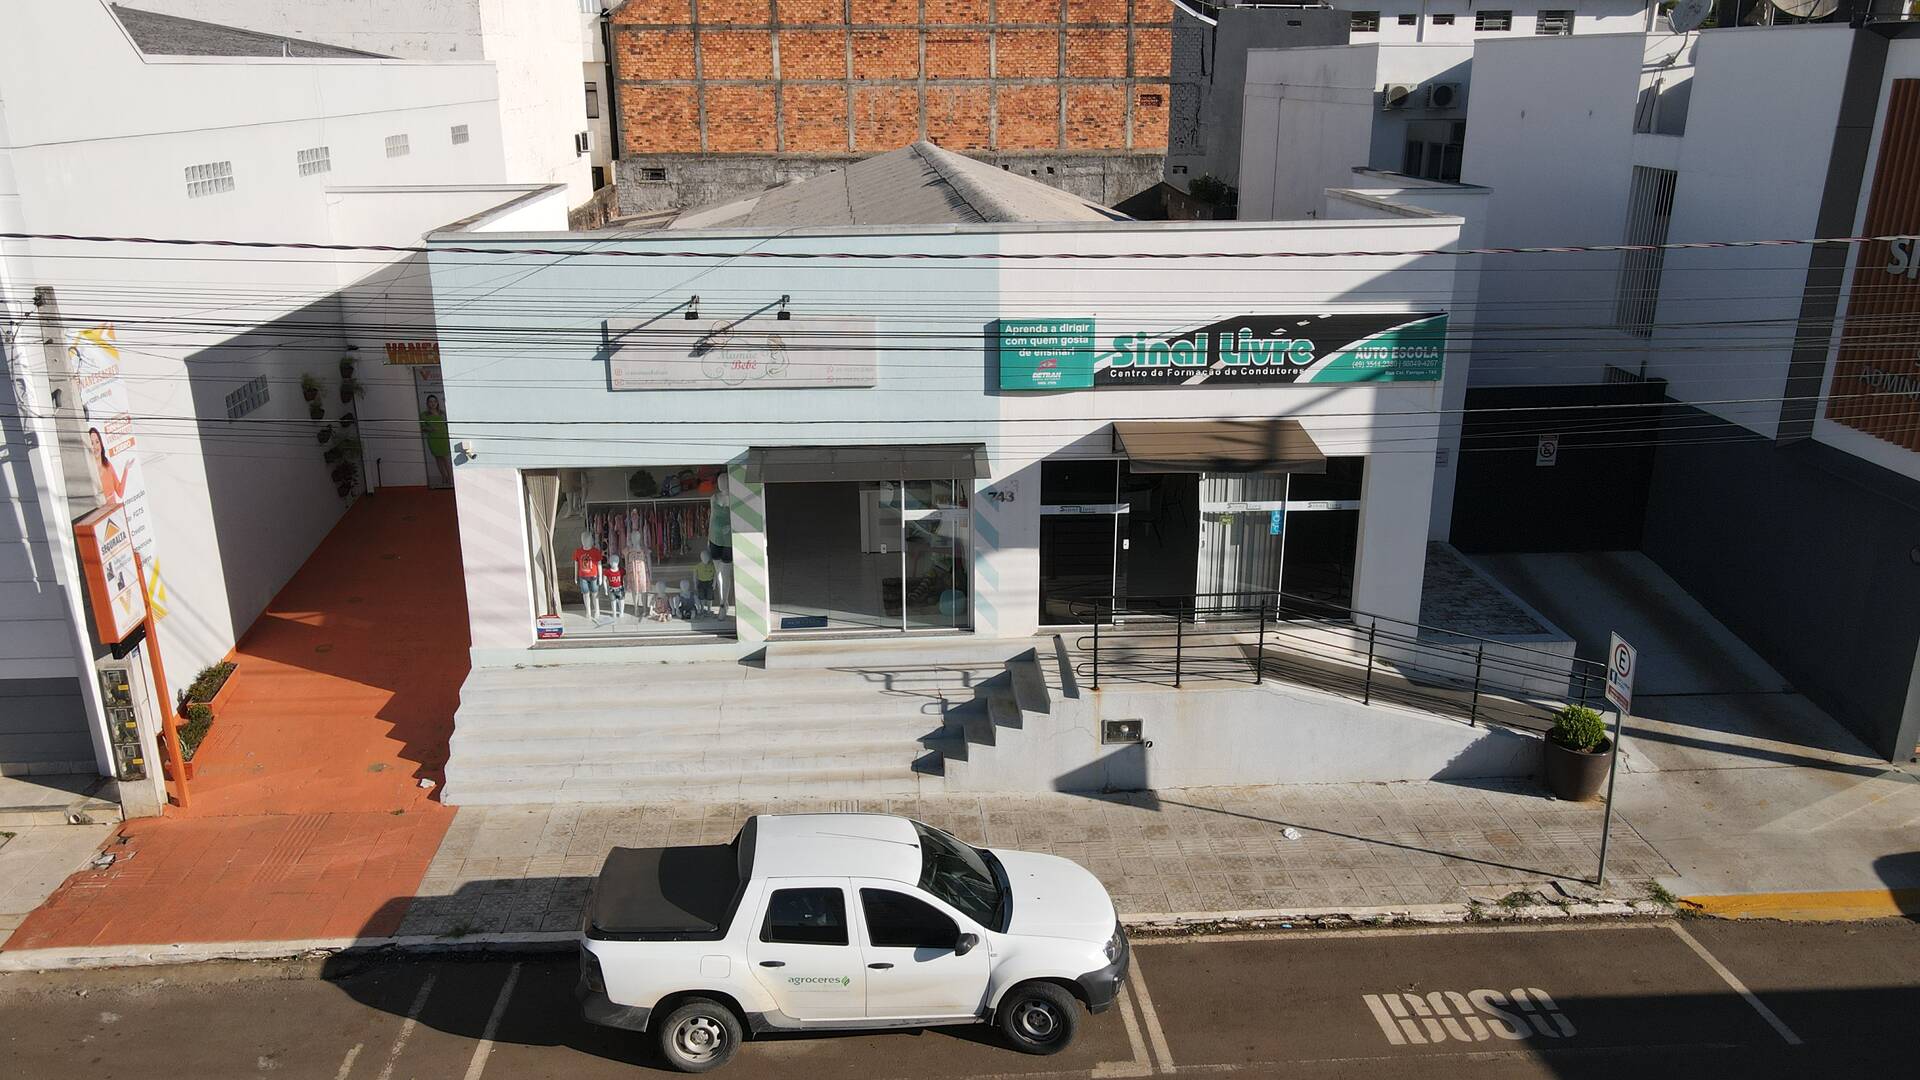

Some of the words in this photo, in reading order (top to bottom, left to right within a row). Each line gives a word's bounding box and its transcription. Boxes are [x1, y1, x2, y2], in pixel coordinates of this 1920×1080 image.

[1005, 324, 1048, 335] Aprenda
[1059, 323, 1090, 334] dirigir
[1005, 338, 1027, 346] com
[1030, 337, 1058, 347] quem
[1060, 336, 1089, 346] gosta
[1110, 331, 1209, 367] Sinal
[1219, 327, 1316, 366] Livre
[1018, 348, 1032, 357] de
[1354, 346, 1388, 359] AUTO
[1391, 345, 1439, 359] ESCOLA
[1110, 369, 1147, 378] Centro
[1150, 368, 1164, 377] de
[1167, 367, 1220, 378] Formação
[1224, 367, 1238, 376] de
[1240, 366, 1304, 376] Condutores
[988, 491, 1015, 503] 743
[101, 531, 127, 556] SEGURALTA
[1619, 649, 1627, 671] E
[787, 976, 841, 986] agroceres
[1361, 987, 1578, 1046] IDOSO
